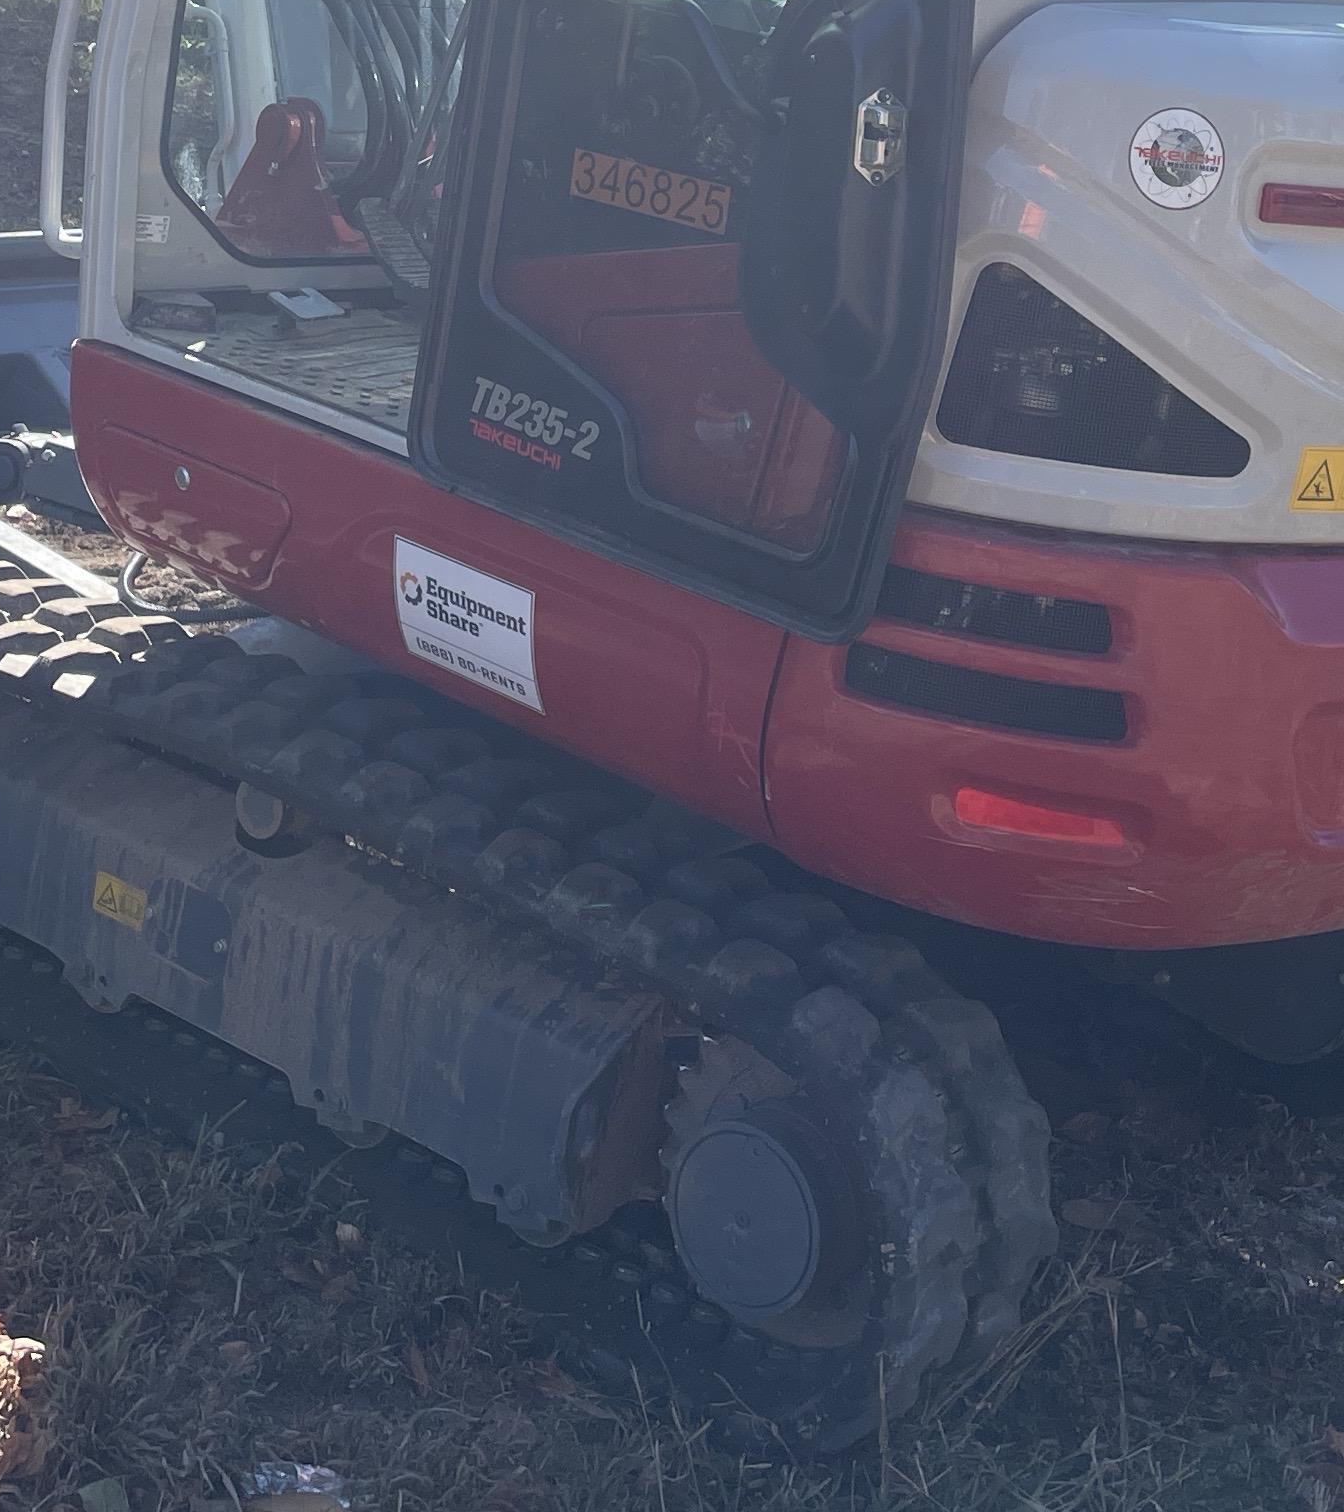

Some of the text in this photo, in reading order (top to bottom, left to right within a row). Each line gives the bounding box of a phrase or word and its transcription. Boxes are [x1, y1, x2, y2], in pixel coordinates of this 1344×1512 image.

[574, 152, 727, 229] 346825
[471, 375, 600, 461] TB235-2
[425, 575, 527, 637] Equipment
[426, 599, 480, 637] Share
[416, 637, 455, 665] (888)
